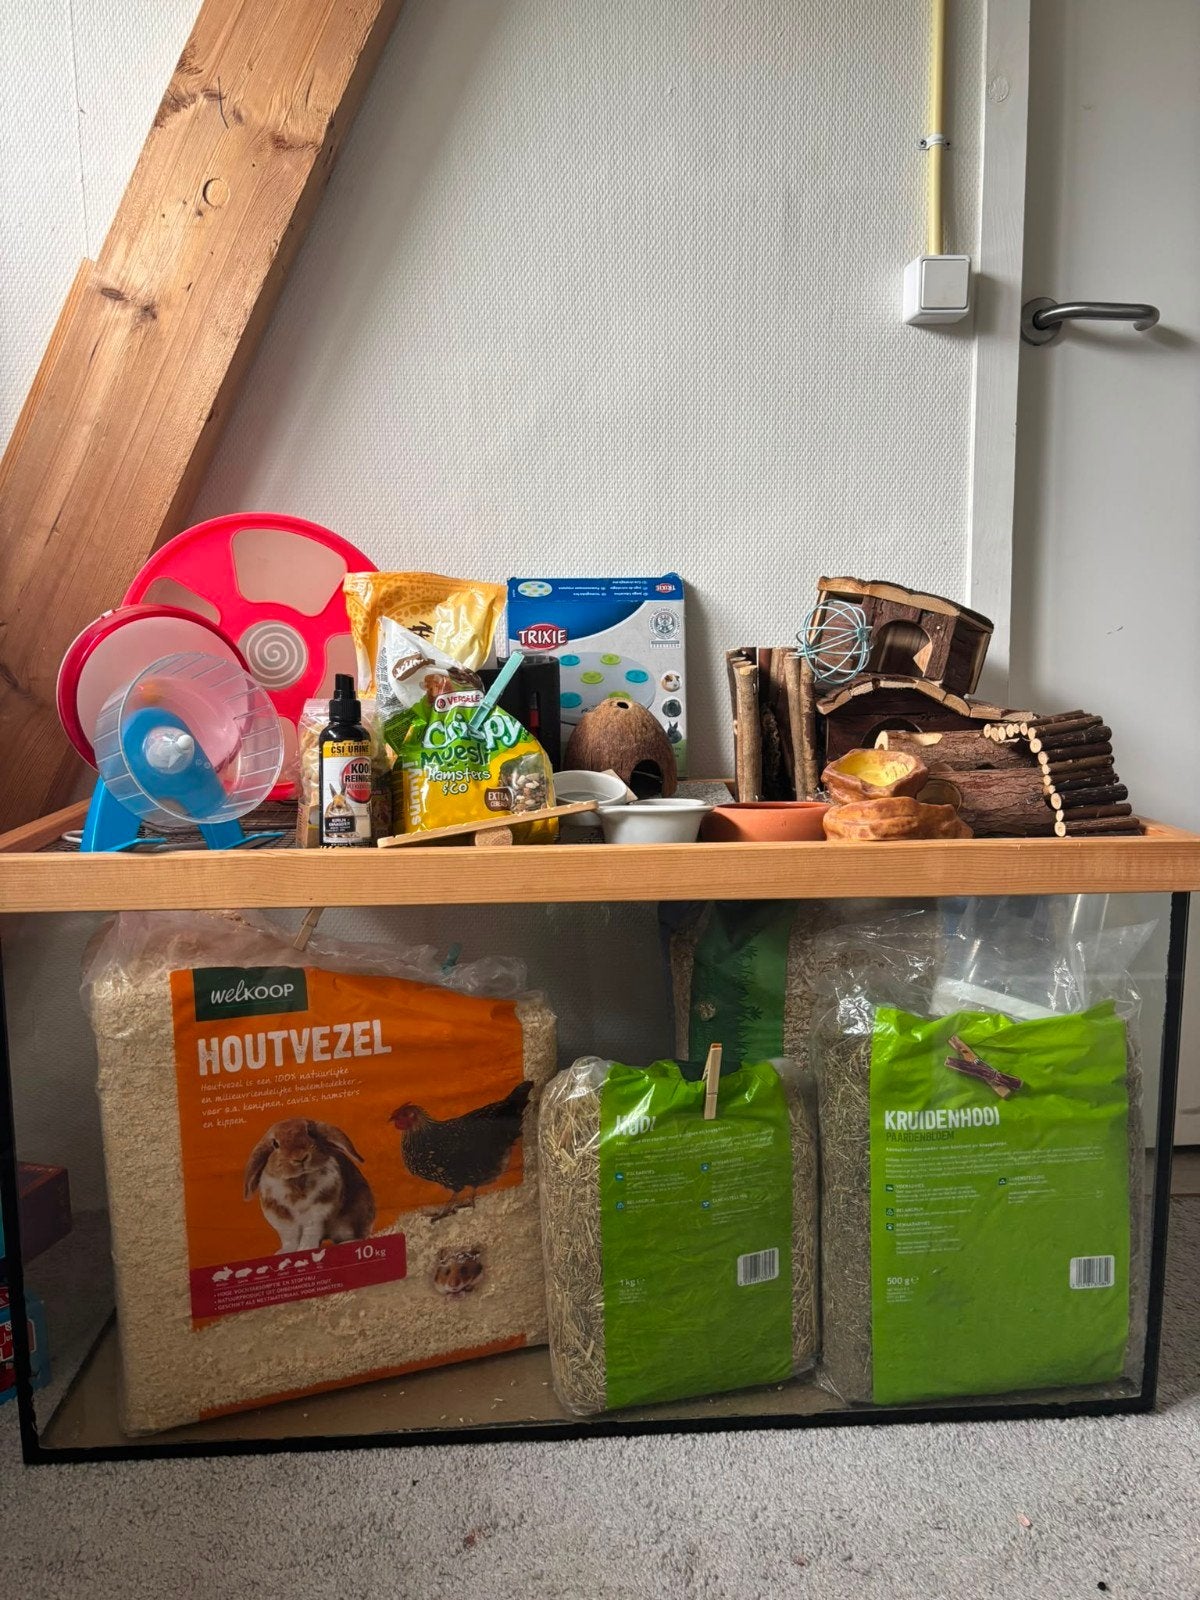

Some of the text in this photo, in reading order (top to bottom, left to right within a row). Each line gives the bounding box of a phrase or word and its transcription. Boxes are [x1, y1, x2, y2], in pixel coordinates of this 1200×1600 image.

[518, 629, 567, 645] TRIXIE
[330, 744, 370, 754] CSI URINE
[424, 765, 491, 782] Hamsters
[197, 1019, 392, 1076] HOUTVEZEL
[299, 1067, 349, 1080] natuurlijke
[202, 1096, 212, 1104] en
[215, 1086, 292, 1102] milieuvriendelijke
[202, 1107, 222, 1116] voor
[321, 1088, 360, 1101] hamsters
[203, 1121, 213, 1129] en
[884, 1106, 1000, 1131] KRUIDENHOOI
[885, 1130, 955, 1143] PAARDENBLOEM
[354, 1245, 387, 1260] 10 kg
[887, 1276, 903, 1285] 500
